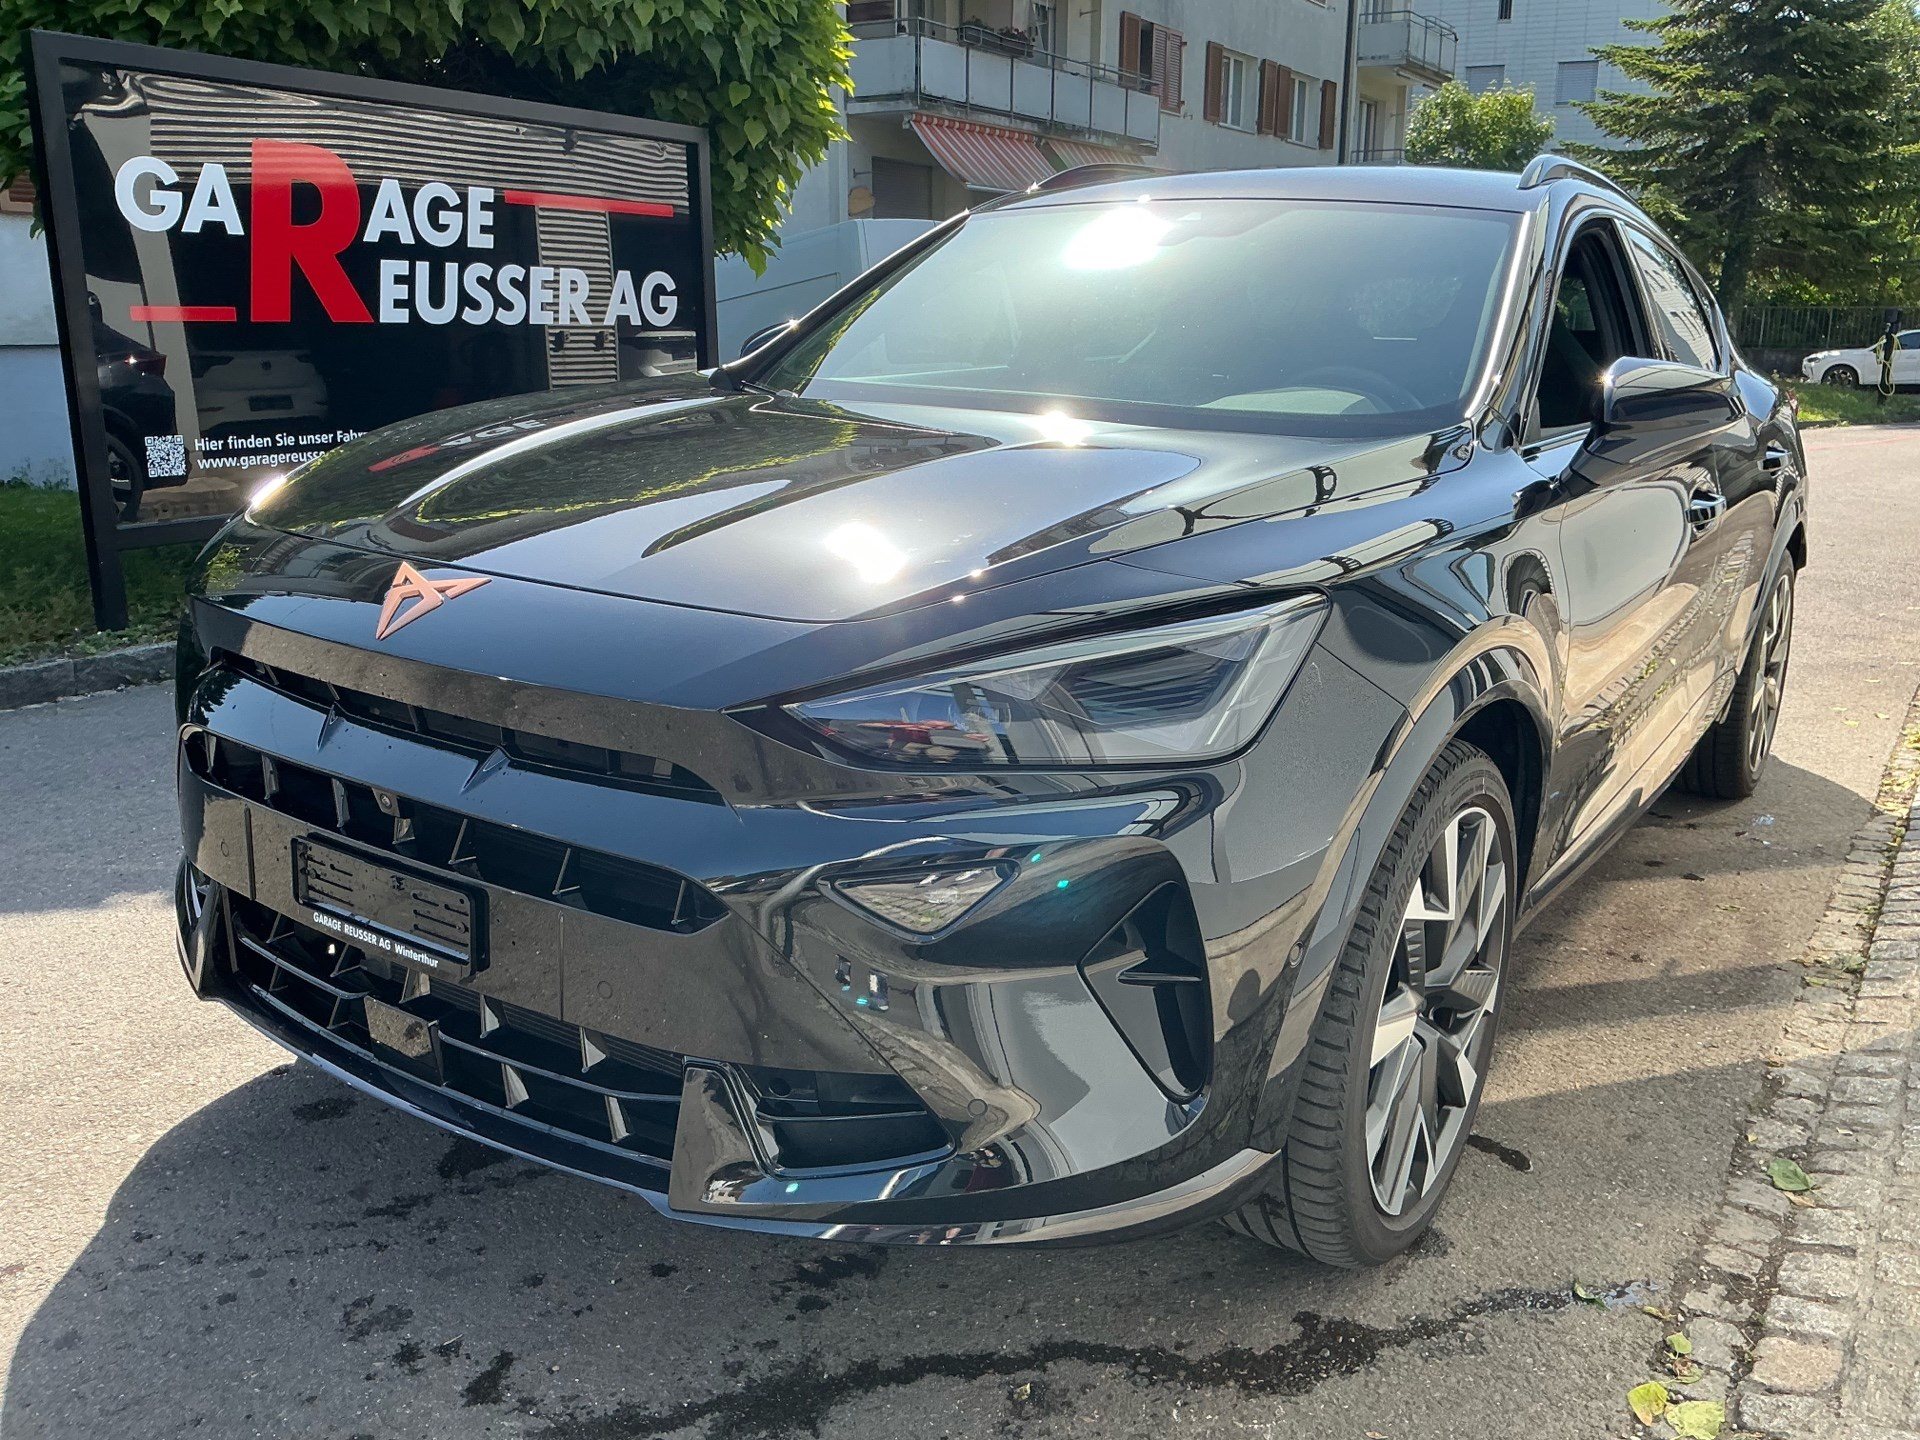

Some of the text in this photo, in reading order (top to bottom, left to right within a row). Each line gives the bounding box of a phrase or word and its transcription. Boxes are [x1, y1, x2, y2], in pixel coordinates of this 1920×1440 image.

[114, 137, 494, 323] GARAGE
[603, 270, 678, 327] AG
[194, 429, 369, 451] Hier finden Sie unser Fahr
[313, 911, 439, 968] GARAGE REUSSER AG Winterthur
